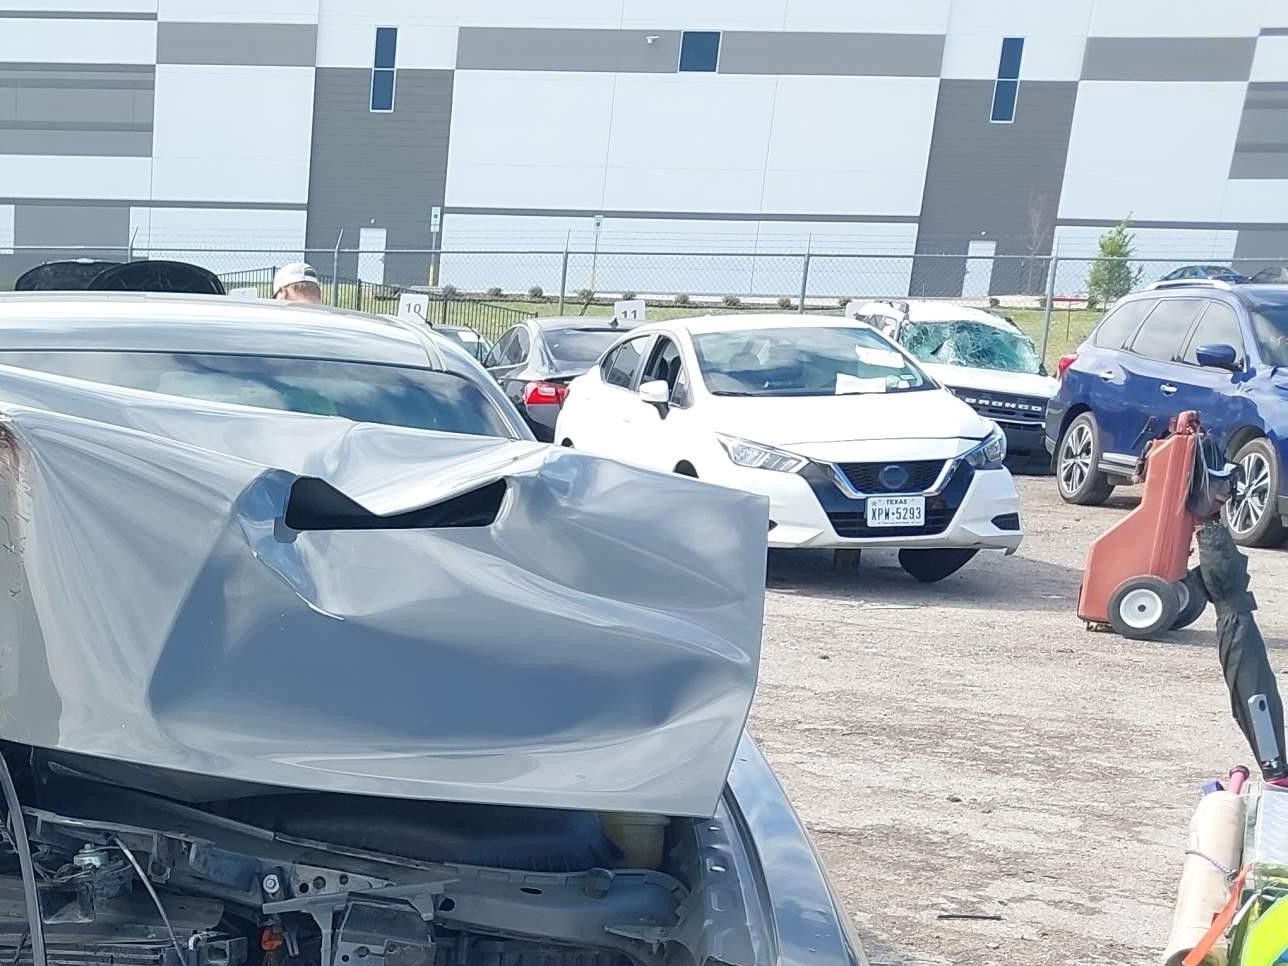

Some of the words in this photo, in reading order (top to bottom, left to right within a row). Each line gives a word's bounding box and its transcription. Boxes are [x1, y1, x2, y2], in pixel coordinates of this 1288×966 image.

[406, 302, 421, 314] 10
[621, 309, 637, 319] 11
[965, 397, 1042, 411] BRONCO
